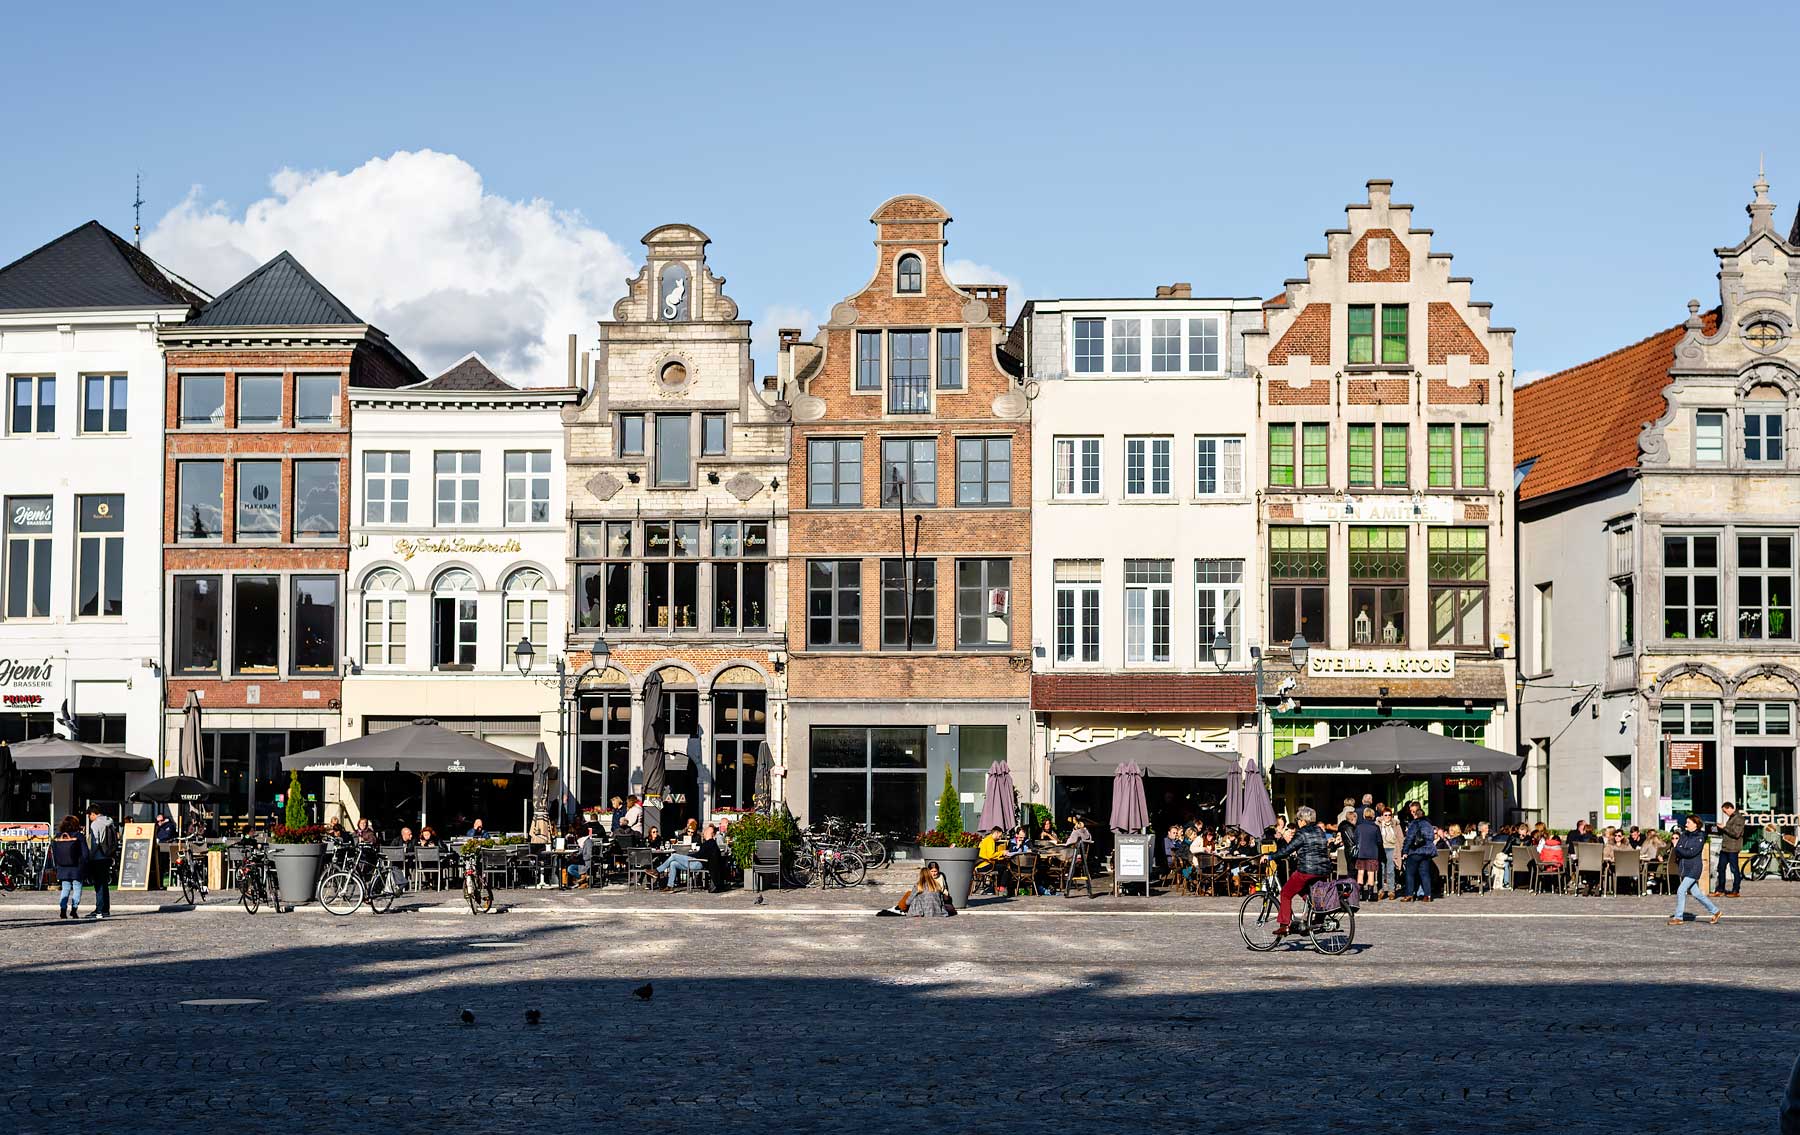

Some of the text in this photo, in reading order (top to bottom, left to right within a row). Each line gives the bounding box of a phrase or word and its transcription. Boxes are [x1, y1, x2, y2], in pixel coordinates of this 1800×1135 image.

[1312, 657, 1451, 673] STELLA ARTOIS
[3, 694, 43, 705] PRIMUS
